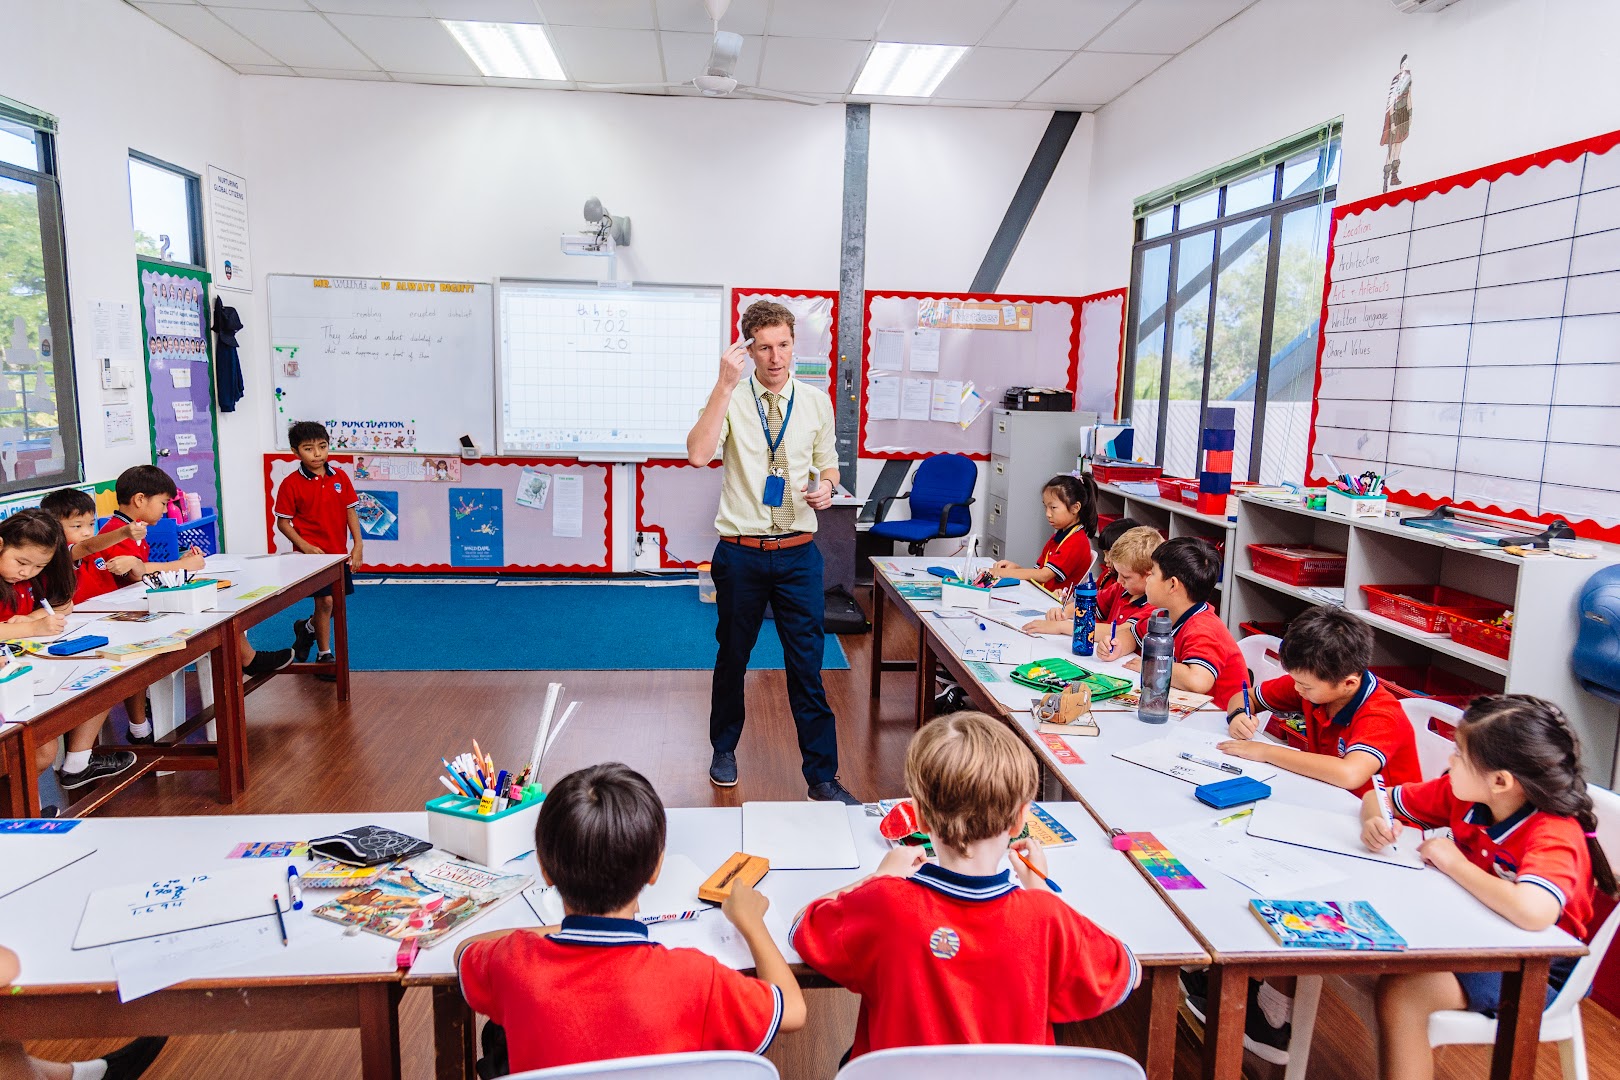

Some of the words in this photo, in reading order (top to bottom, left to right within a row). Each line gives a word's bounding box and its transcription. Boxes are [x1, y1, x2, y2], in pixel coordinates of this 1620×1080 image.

[218, 176, 238, 190] NURTURING
[214, 184, 228, 195] GLOBAL
[228, 187, 244, 200] CITIZENS
[1342, 222, 1372, 239] Location
[1338, 248, 1380, 272] Architecture
[314, 278, 332, 289] MR.
[332, 279, 368, 290] WHITE
[381, 281, 390, 291] IS
[396, 282, 436, 292] ALWAYS
[440, 283, 475, 294] RIGHT!
[1332, 282, 1346, 300] Art
[1358, 278, 1390, 296] Artefacts
[954, 310, 998, 322] Notices
[1331, 312, 1358, 328] Written
[1364, 306, 1388, 328] language
[1351, 340, 1371, 356] Values
[380, 461, 435, 479] English
